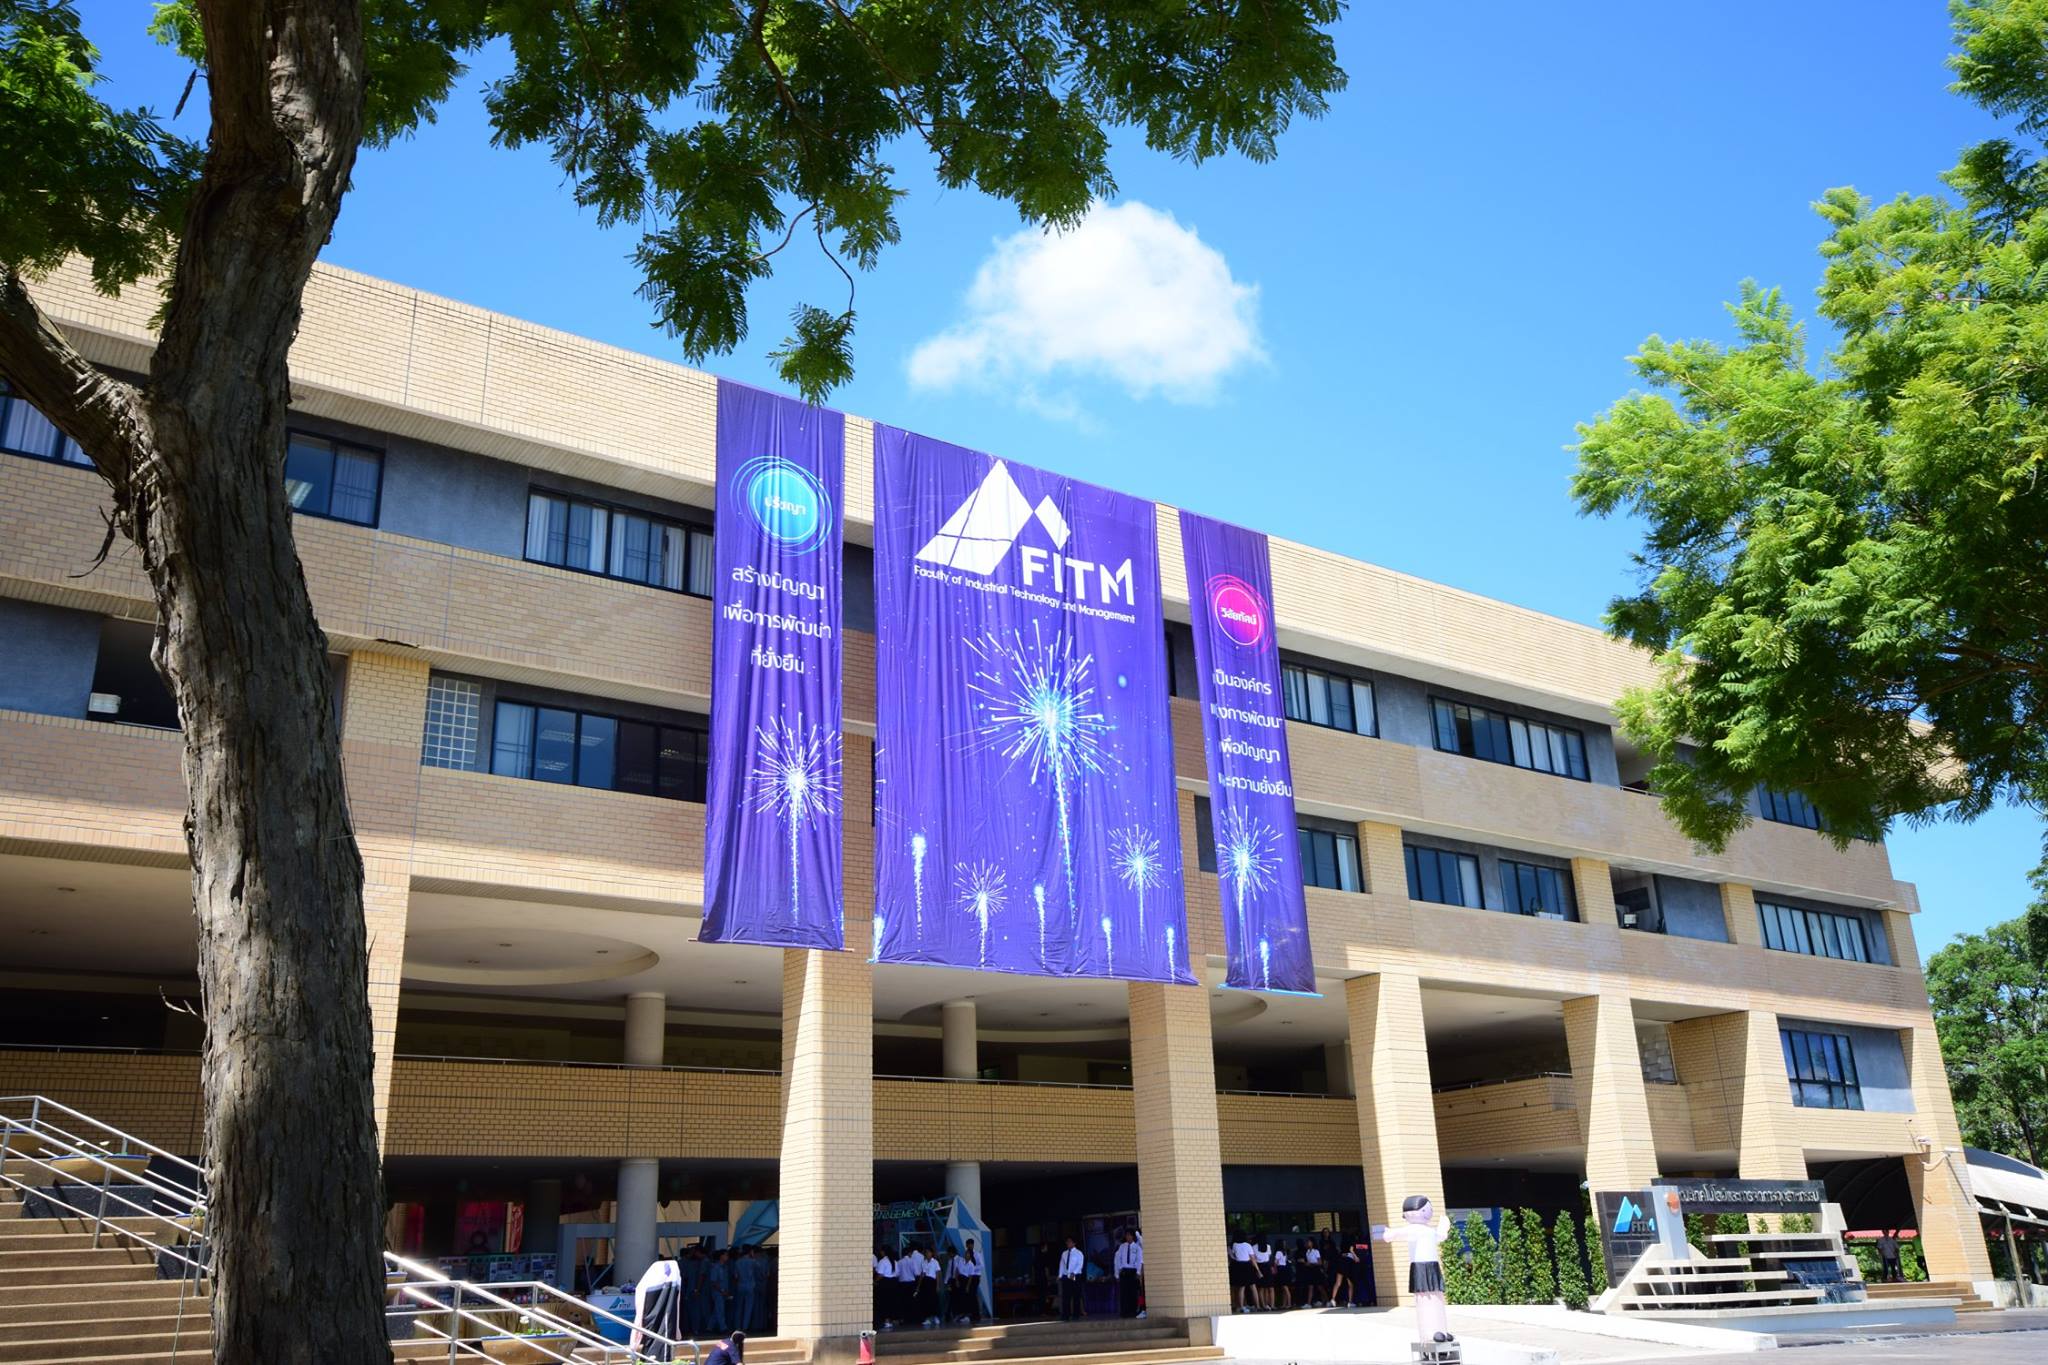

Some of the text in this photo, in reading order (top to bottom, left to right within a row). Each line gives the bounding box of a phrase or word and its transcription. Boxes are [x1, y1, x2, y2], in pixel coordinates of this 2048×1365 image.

[914, 565, 949, 582] Faculty
[951, 575, 962, 585] of
[965, 578, 1008, 594] Industrial
[1010, 585, 1061, 609] Technology
[1079, 604, 1135, 624] Management
[1021, 544, 1135, 606] FITM
